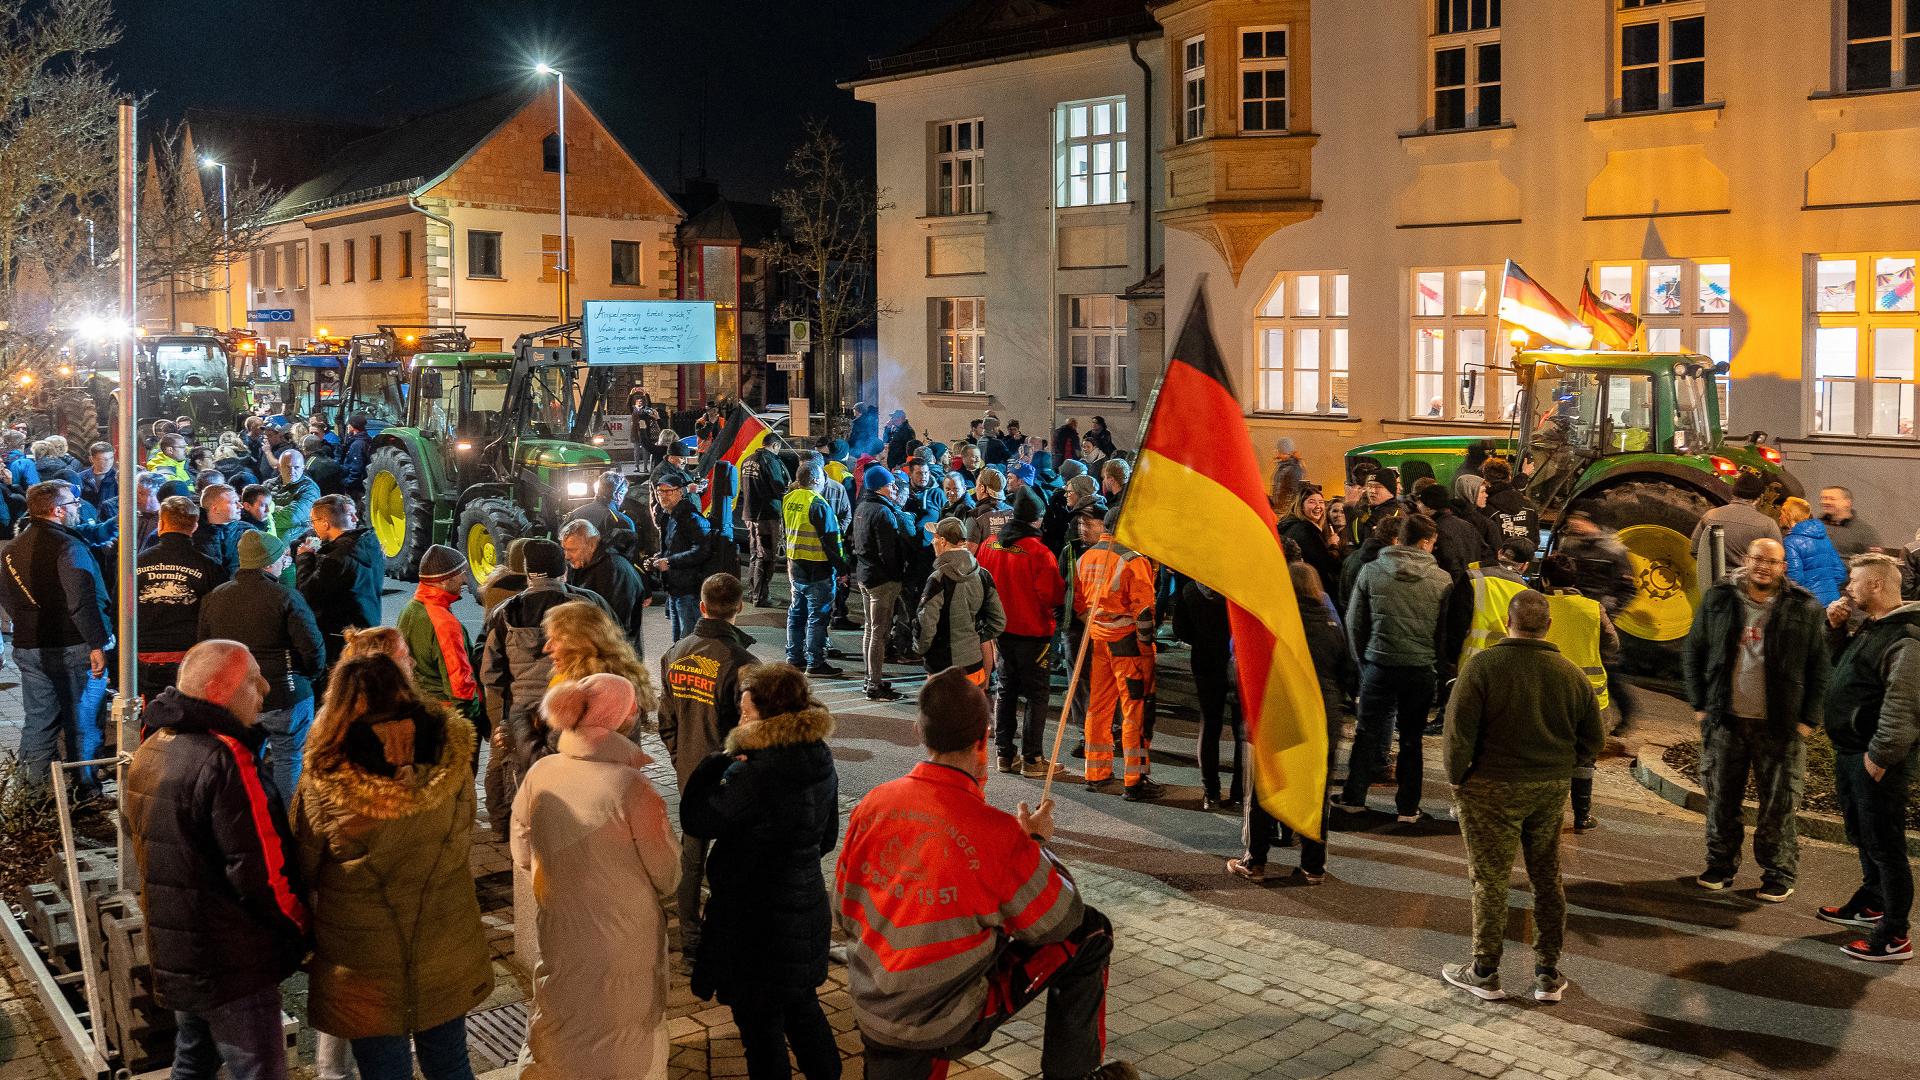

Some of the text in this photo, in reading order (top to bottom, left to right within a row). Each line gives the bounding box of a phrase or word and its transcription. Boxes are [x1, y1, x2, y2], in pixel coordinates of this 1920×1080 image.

[148, 572, 188, 582] Dormitz
[673, 664, 703, 675] HOLZBAU
[669, 671, 716, 692] LIPFERT
